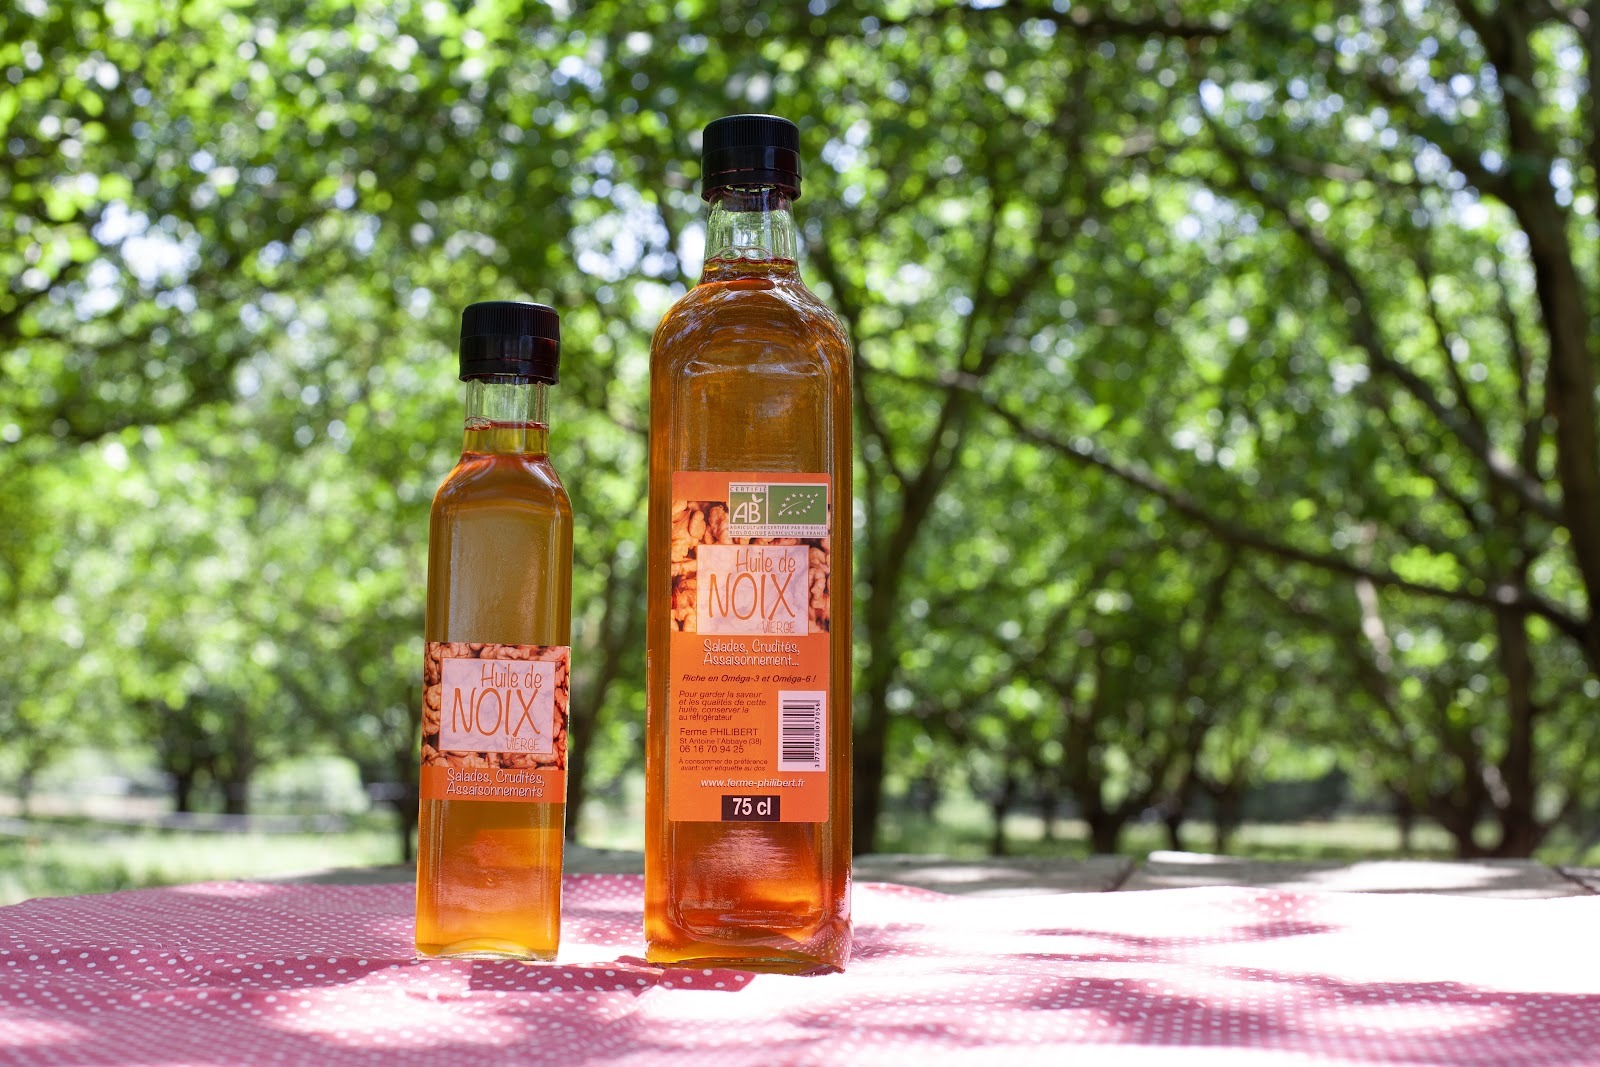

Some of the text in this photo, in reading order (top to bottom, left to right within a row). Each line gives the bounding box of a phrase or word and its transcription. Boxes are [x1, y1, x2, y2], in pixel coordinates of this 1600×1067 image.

[732, 502, 761, 523] AB
[736, 549, 796, 573] Huile de
[709, 573, 796, 621] NOIX
[761, 621, 796, 634] VIERGE
[703, 639, 801, 655] Salades, Crudités,
[481, 663, 543, 689] Huile de
[682, 674, 706, 682] Riche
[721, 674, 760, 684] Oméga-3
[772, 675, 811, 684] Oméga-6
[679, 690, 698, 698] Pour
[700, 690, 726, 700] garder
[702, 699, 732, 707] qualités
[451, 687, 541, 738] NOIX
[679, 706, 699, 714] huile,
[690, 713, 733, 722] réfrigérateur
[680, 728, 759, 736] Ferme PHILIBERT
[506, 738, 540, 751] VIERGE
[749, 738, 762, 746] (38)
[447, 768, 545, 787] Salades, Crudités,
[701, 779, 806, 789] www.ferme-philibert.fr
[446, 781, 544, 798] Assaisonnements
[732, 797, 772, 816] 75 cl
